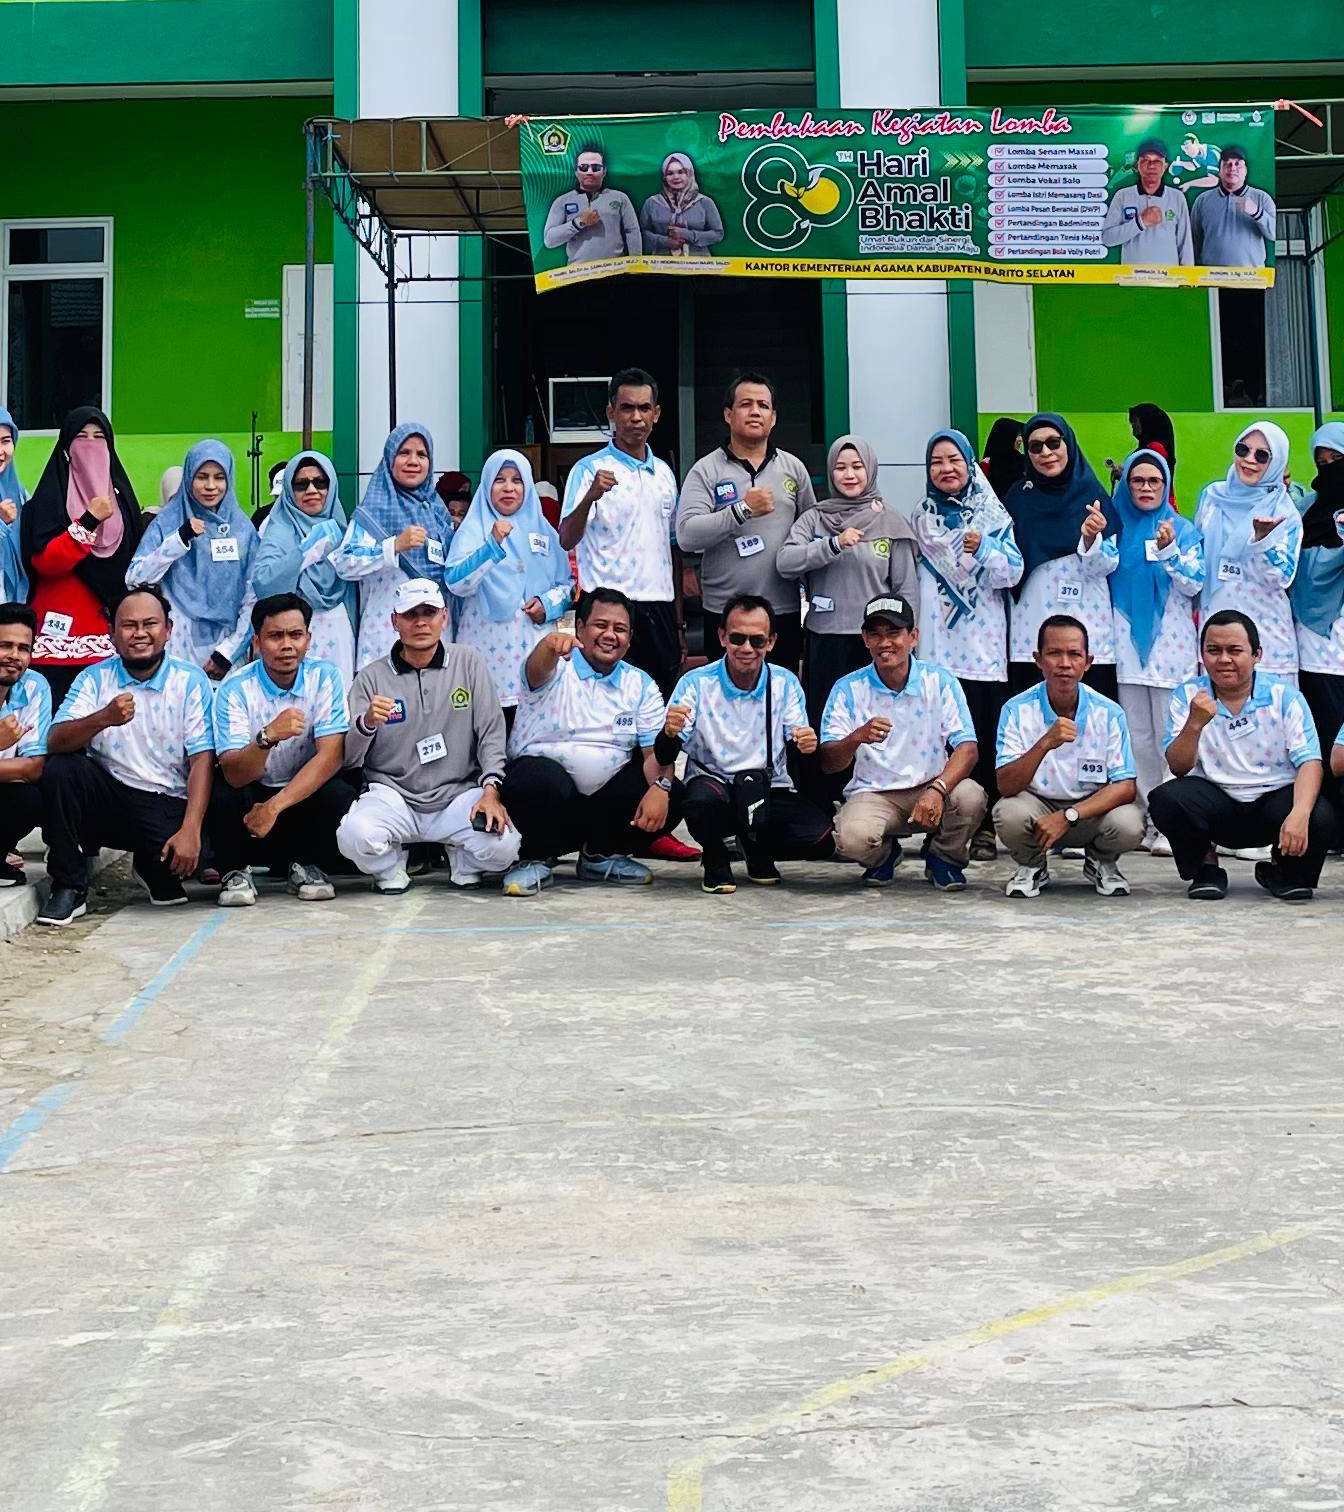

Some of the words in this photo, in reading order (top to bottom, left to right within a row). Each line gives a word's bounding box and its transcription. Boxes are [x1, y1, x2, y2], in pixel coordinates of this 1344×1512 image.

[718, 111, 865, 141] Pembukaan
[872, 109, 983, 145] Kegiatan
[990, 108, 1072, 134] Lomba
[858, 147, 929, 177] Hari
[856, 176, 950, 204] Amal
[858, 203, 972, 231] Bhakti
[1008, 220, 1057, 228] Pertandingan
[939, 235, 970, 245] Sinergi
[1008, 234, 1058, 242] Pertandingan
[959, 245, 979, 253] Maju
[1008, 248, 1052, 256] Pertandingan
[745, 262, 790, 272] KANTOR
[792, 263, 871, 273] KEMENTERIAN
[874, 264, 915, 273] AGAMA
[916, 264, 982, 274] KABUPATEN
[984, 266, 1024, 278] BARITO
[1026, 269, 1075, 278] SELATAN
[1061, 586, 1079, 596] 370
[1228, 717, 1249, 730] 443
[1081, 764, 1103, 773] 493
